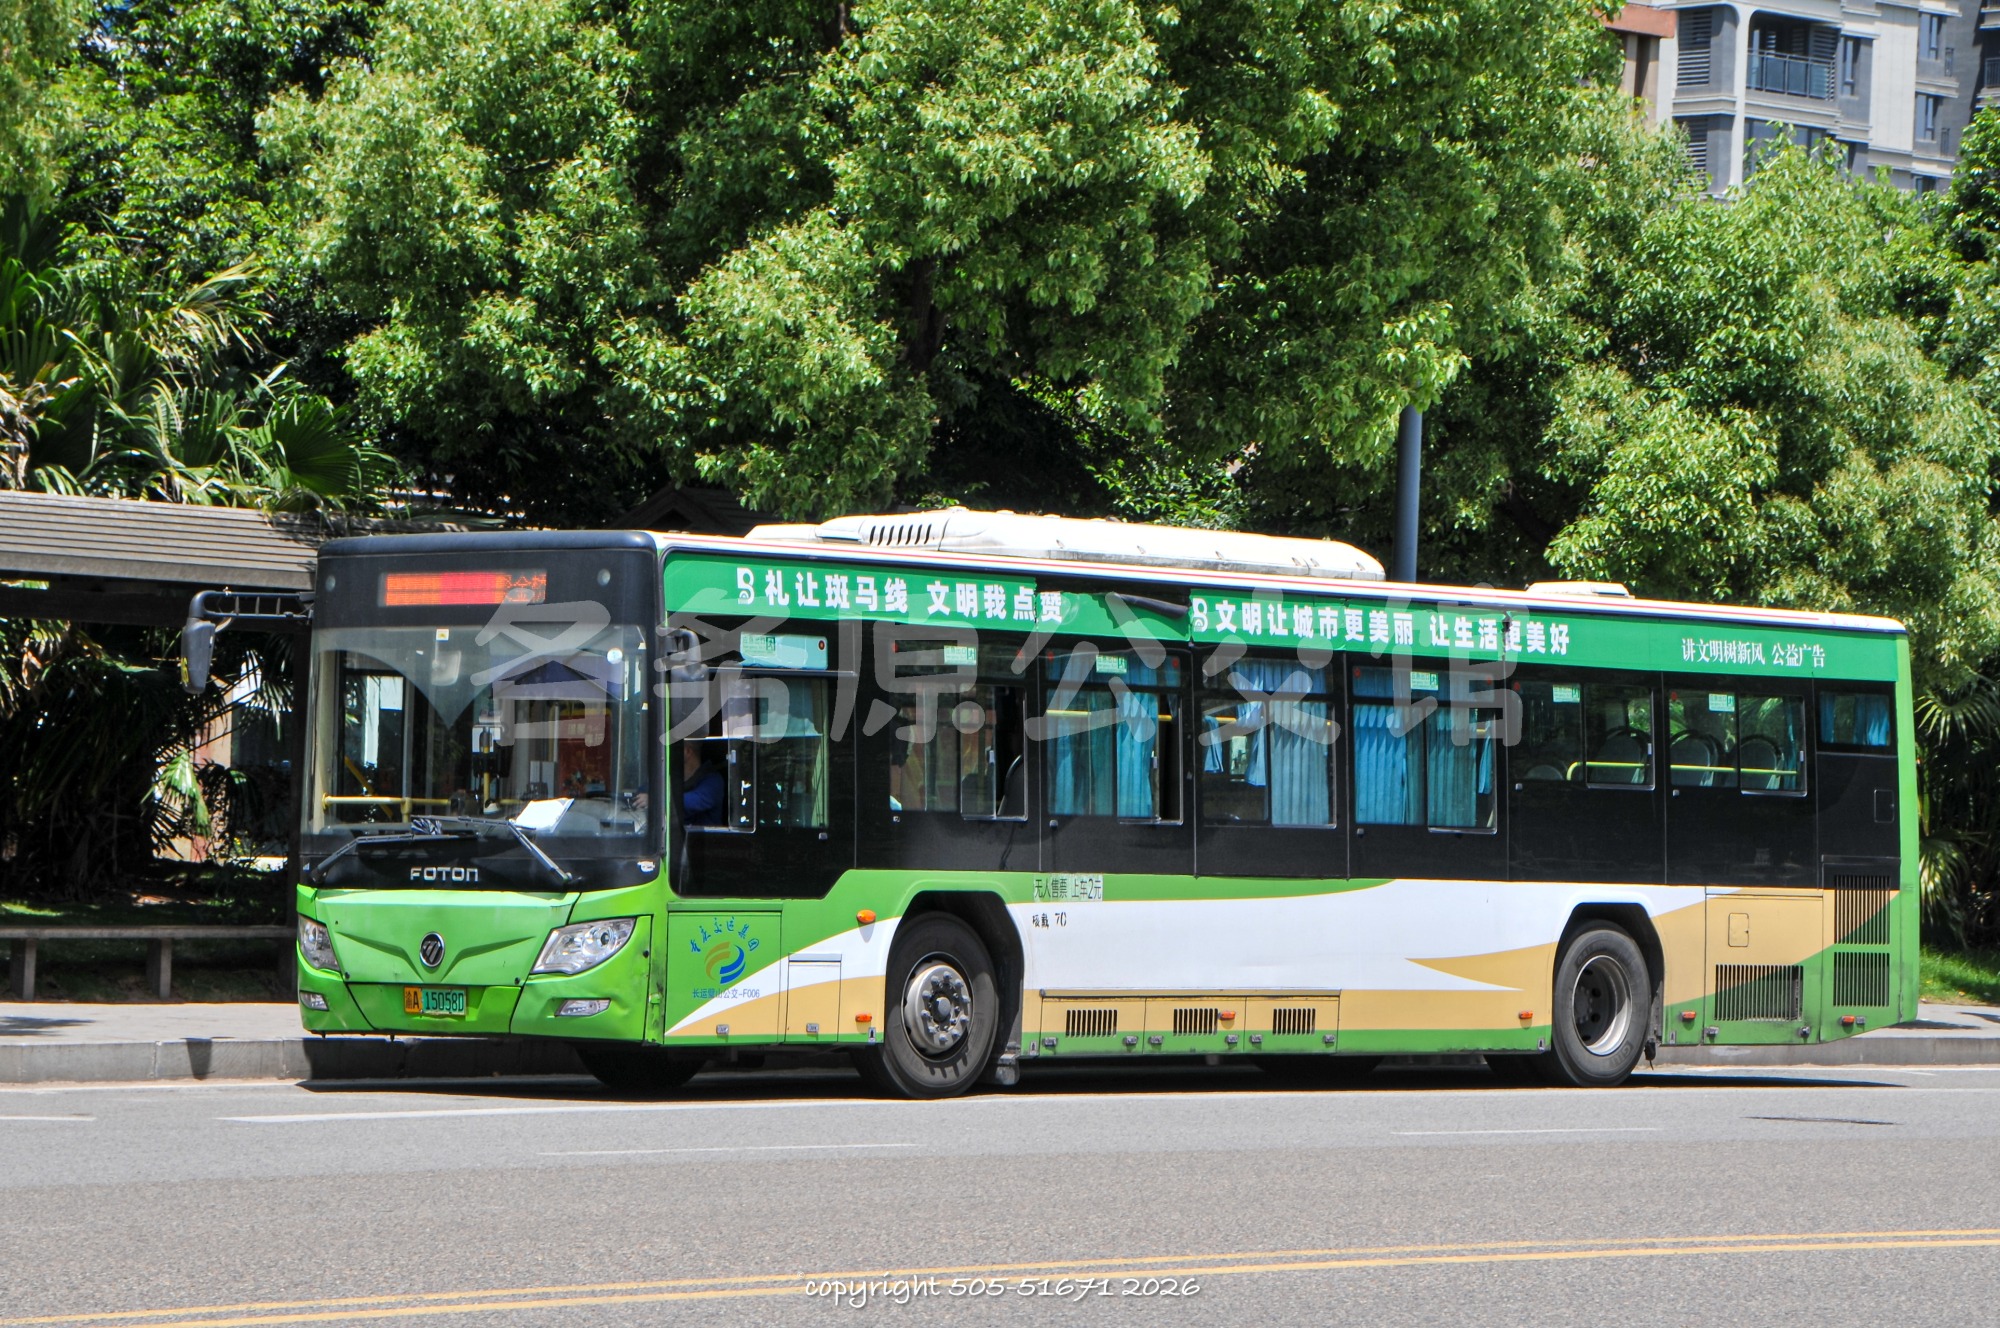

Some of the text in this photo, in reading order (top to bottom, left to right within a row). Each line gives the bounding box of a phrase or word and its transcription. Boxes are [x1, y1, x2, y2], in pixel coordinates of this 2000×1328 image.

[764, 568, 1063, 623] 礼让斑马线 文明我点赞
[1215, 600, 1570, 656] 文明让城市更美丽 让生活更美好
[1681, 638, 1826, 668] 讲文明树新风 公益广告
[410, 866, 479, 882] FOTON
[1034, 878, 1102, 899] 无人售票 上车2元
[1054, 911, 1067, 927] 70
